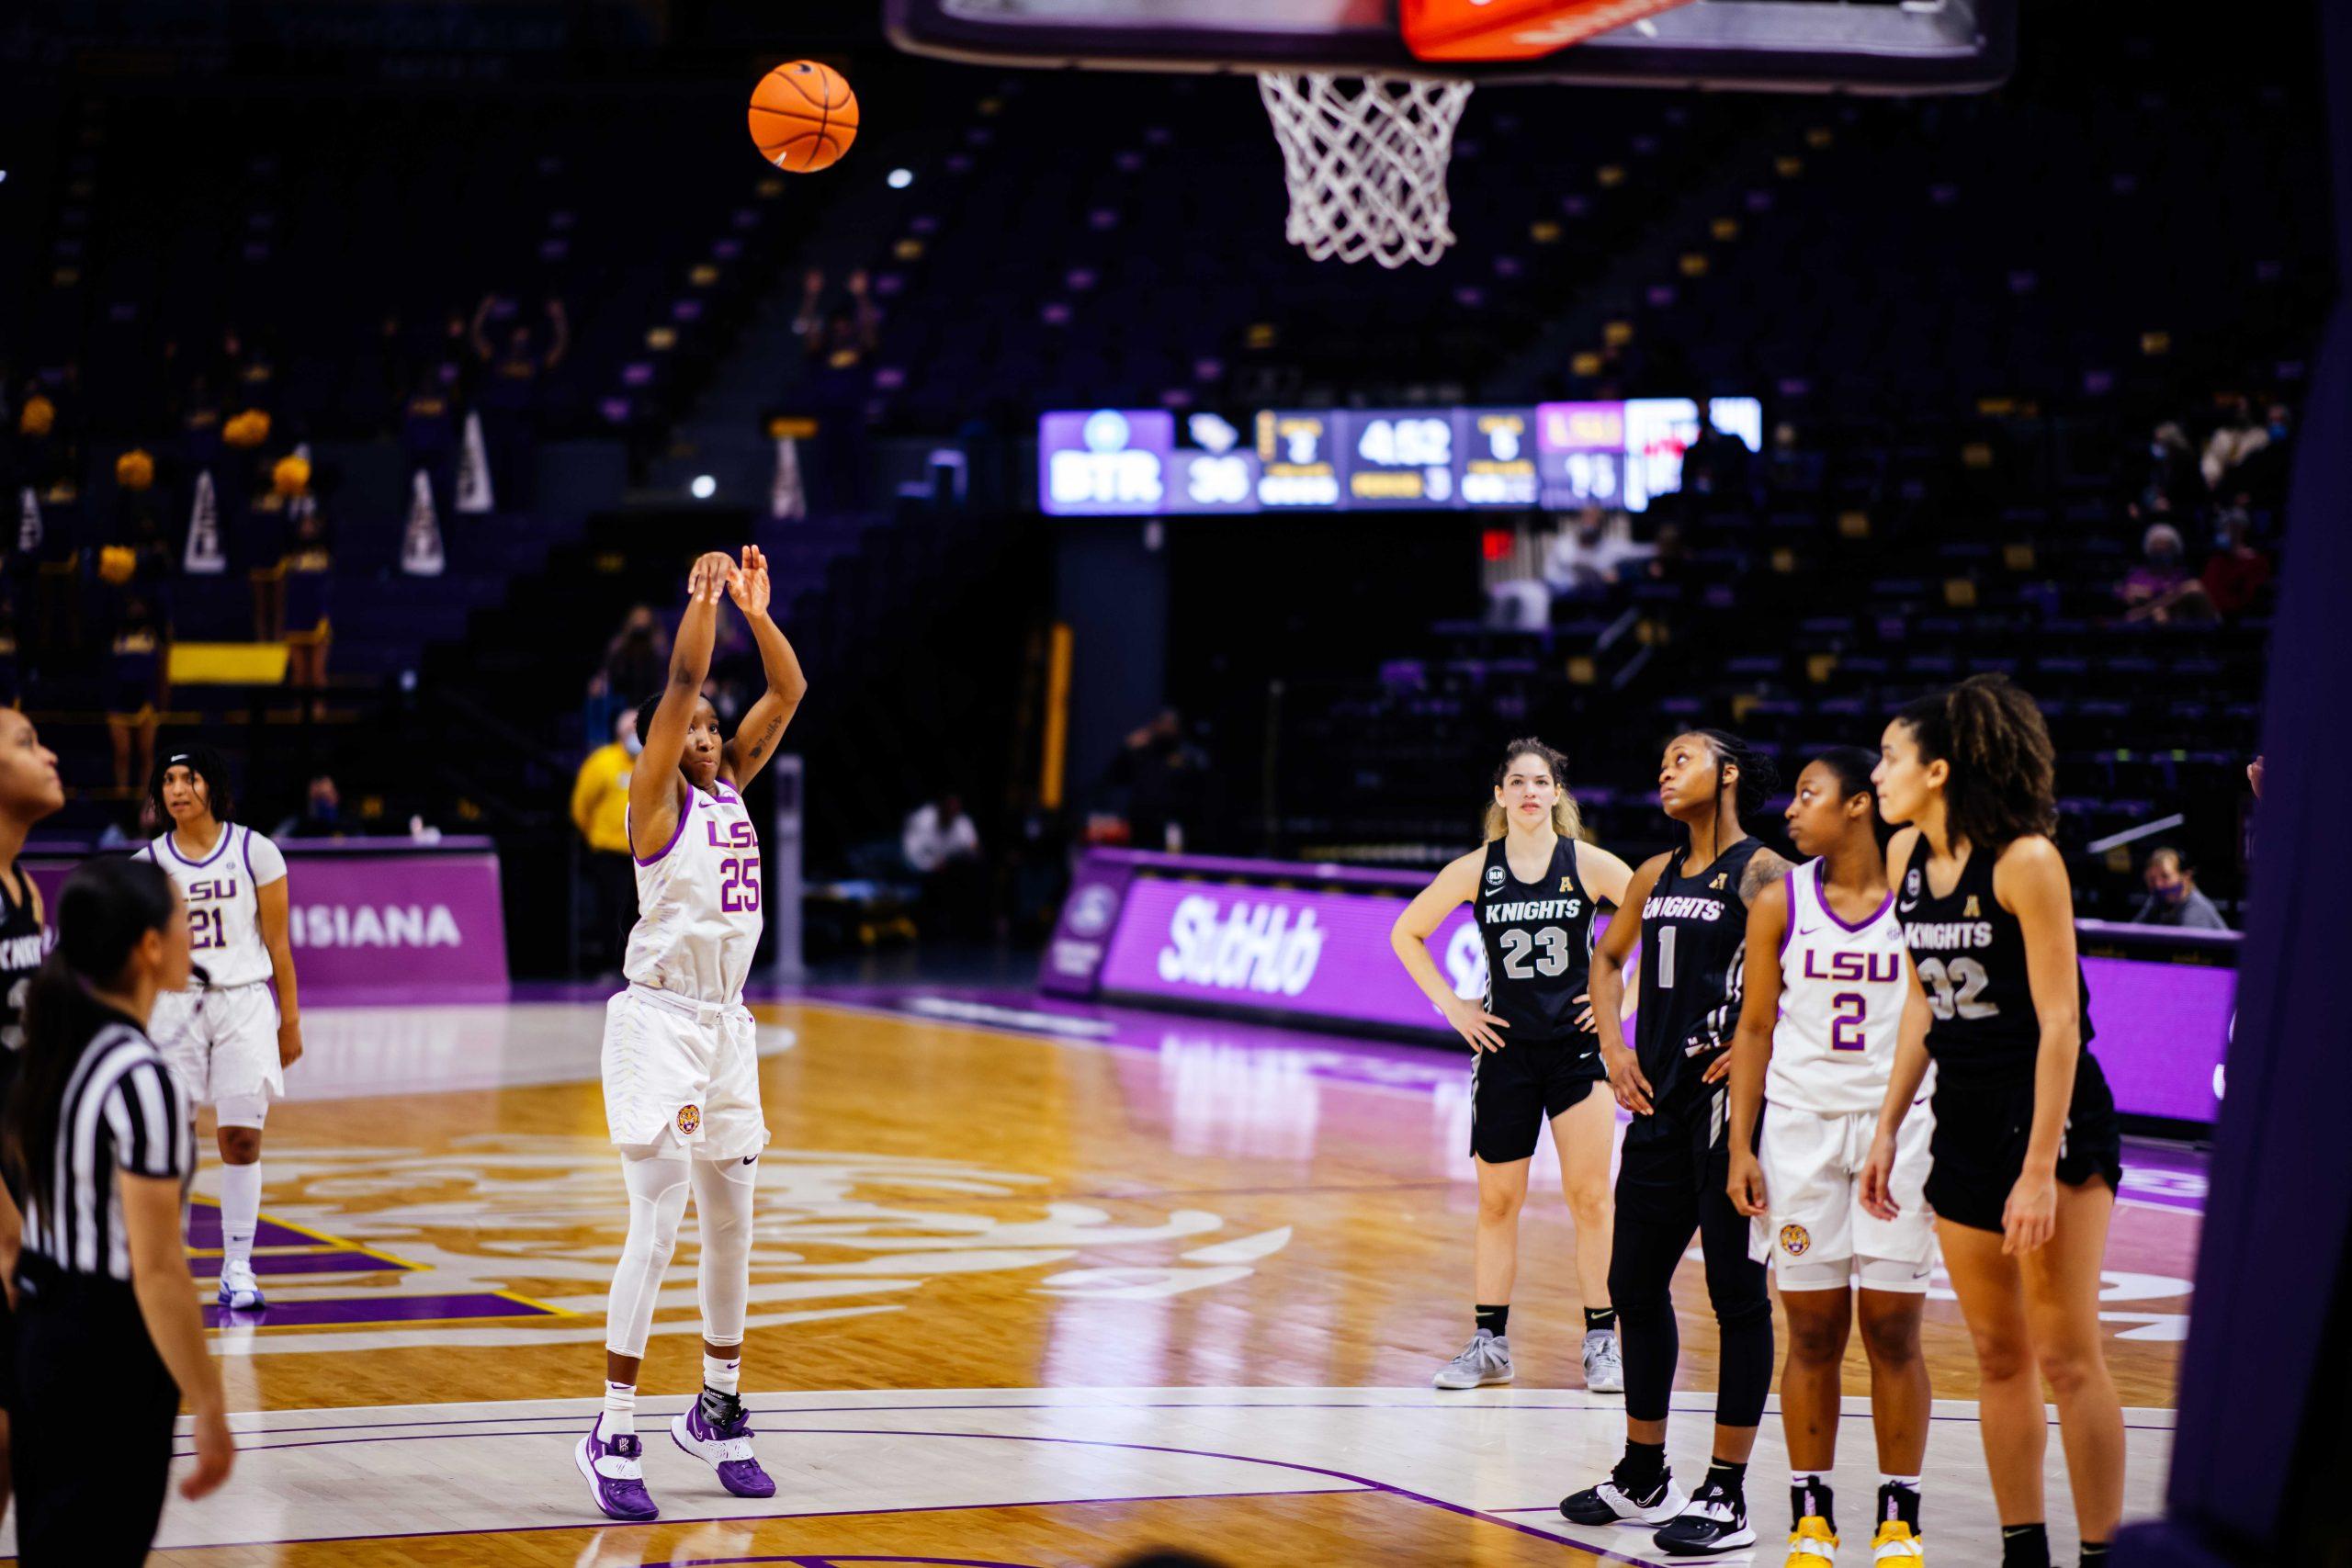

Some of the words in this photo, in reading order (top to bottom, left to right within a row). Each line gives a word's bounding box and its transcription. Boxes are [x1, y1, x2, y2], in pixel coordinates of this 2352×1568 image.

[707, 820, 759, 848] LS
[184, 879, 237, 902] SU
[720, 858, 759, 912] 25
[187, 908, 226, 950] 21
[289, 904, 462, 948] ISIANA
[1486, 899, 1581, 924] KNIGHTS
[1499, 927, 1568, 979] 23
[1658, 926, 1677, 988] 1
[1905, 921, 1994, 950] KNIGHTS
[1804, 949, 1899, 982] LSU
[1917, 956, 2001, 1021] 32
[1833, 992, 1866, 1051] 2
